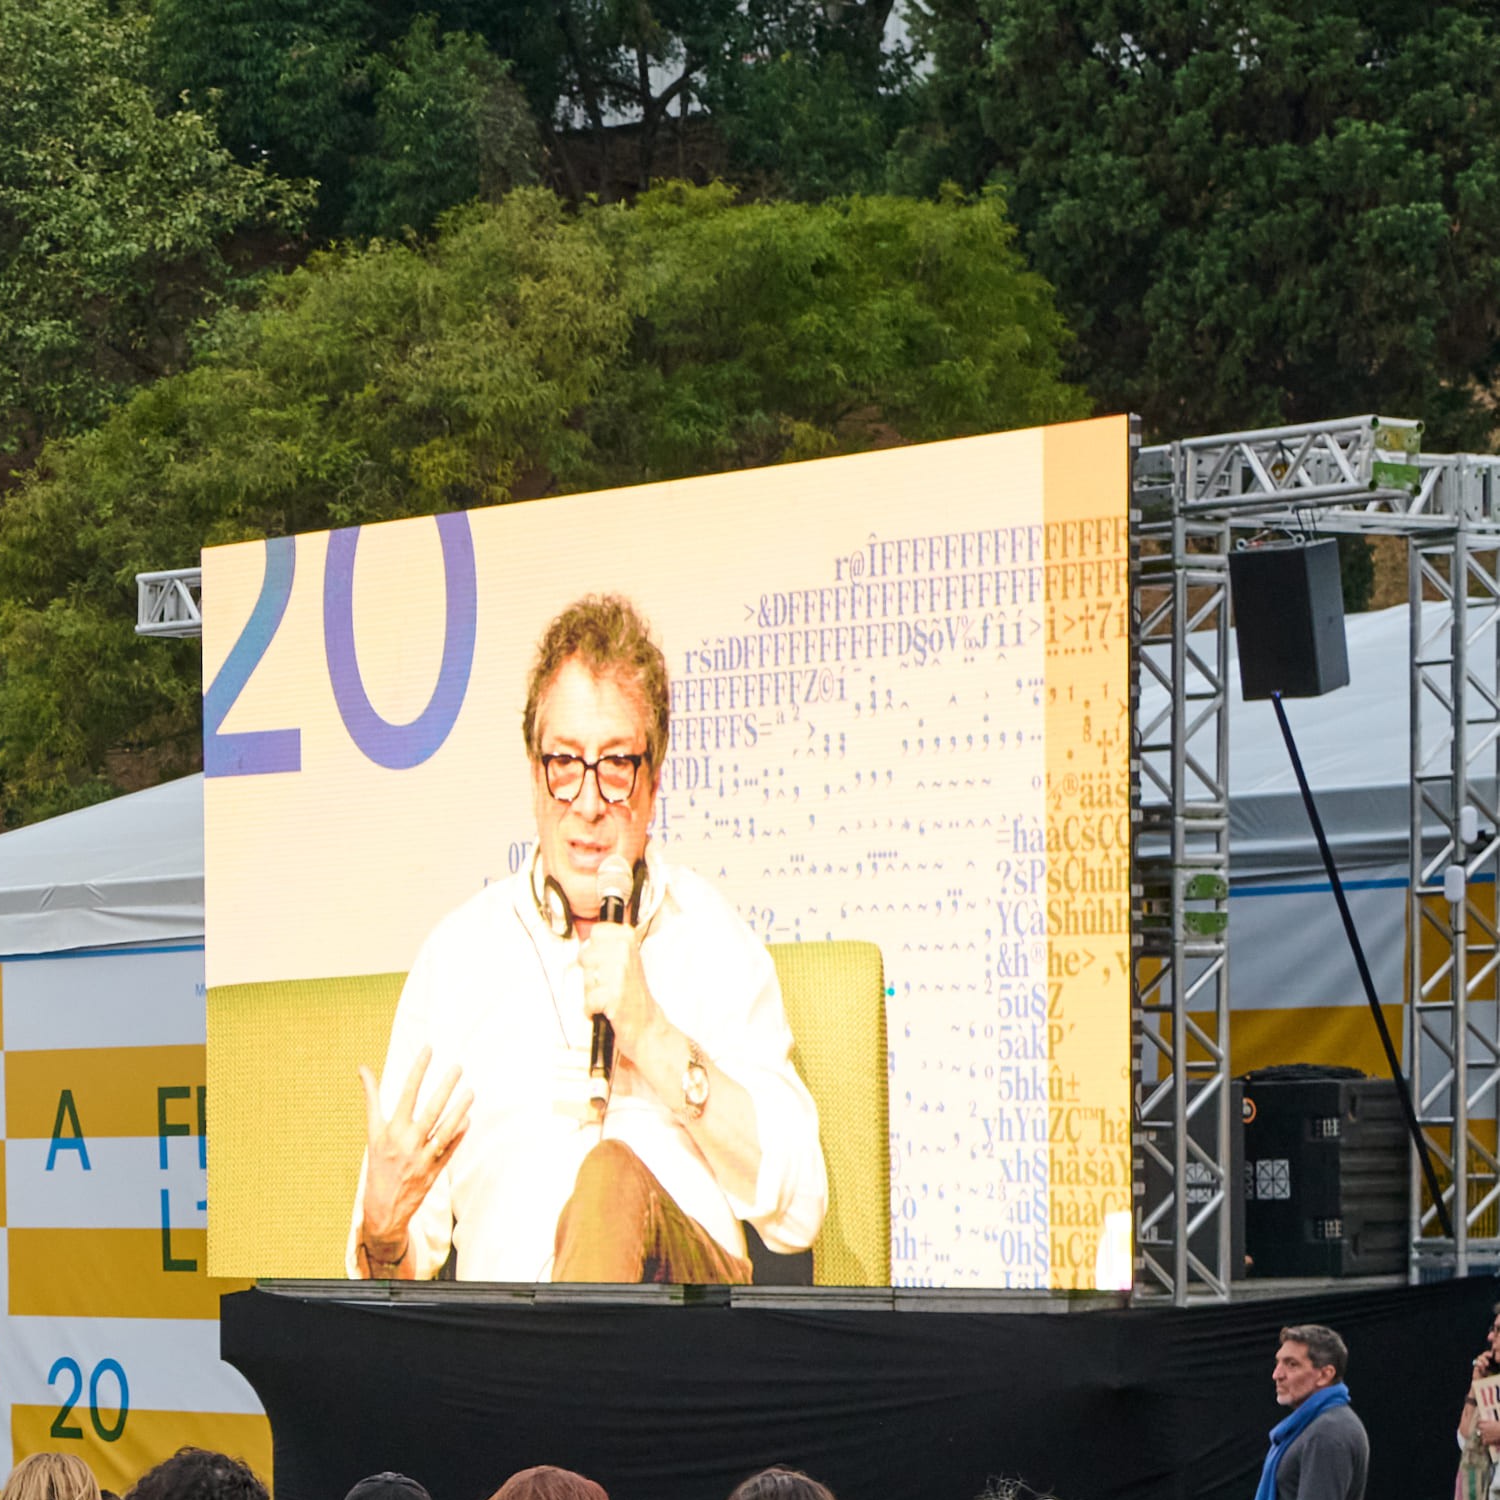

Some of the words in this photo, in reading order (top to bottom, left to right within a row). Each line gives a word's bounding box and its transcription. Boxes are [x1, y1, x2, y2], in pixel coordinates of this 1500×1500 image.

[45, 1089, 92, 1171] A
[157, 1086, 207, 1170] F
[160, 1188, 207, 1272] L
[47, 1356, 129, 1443] 20
